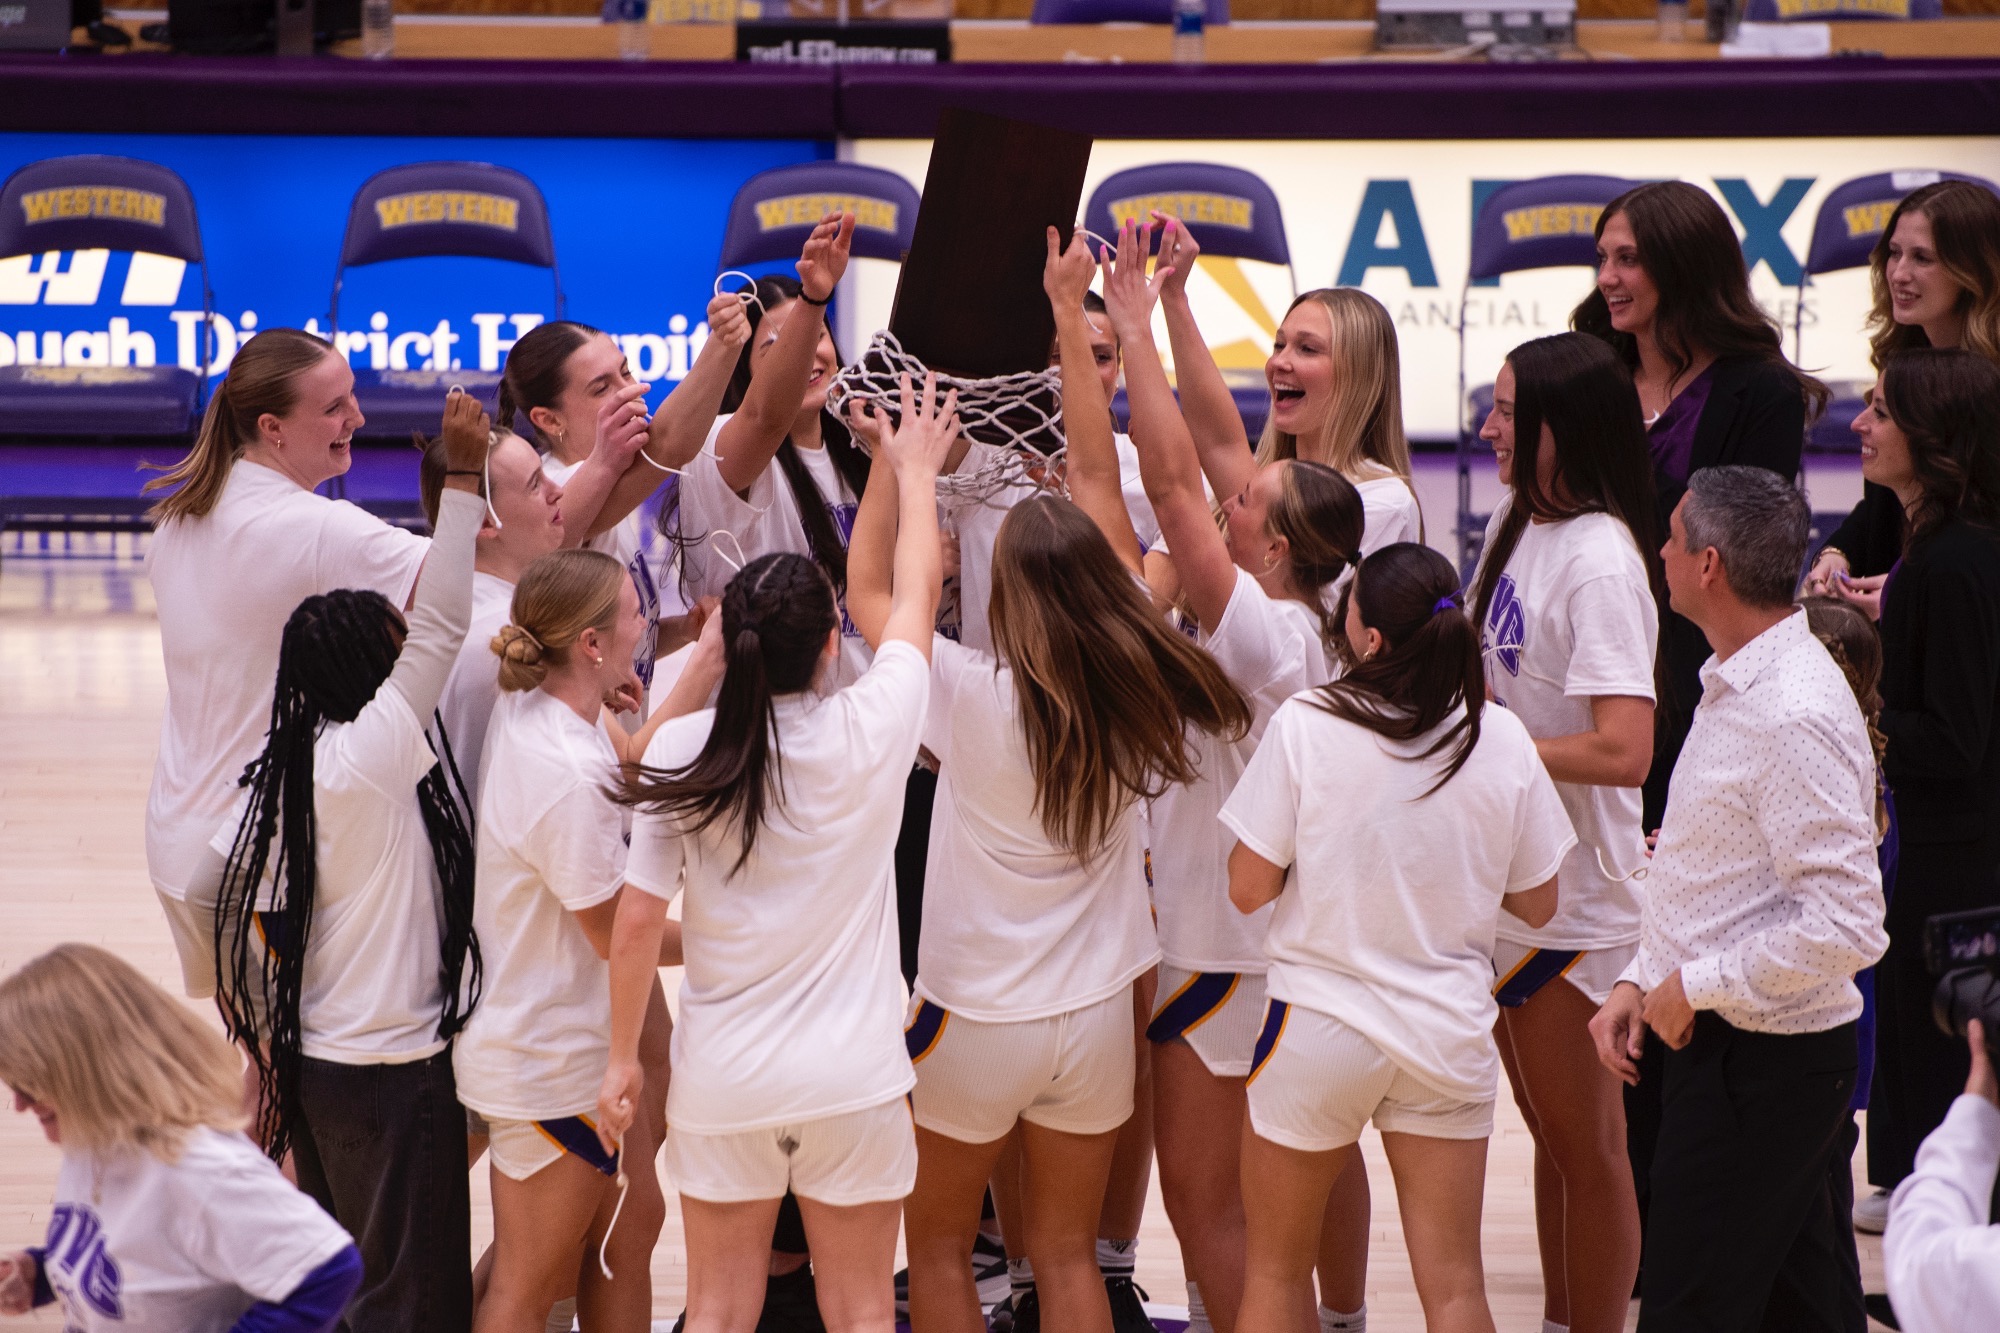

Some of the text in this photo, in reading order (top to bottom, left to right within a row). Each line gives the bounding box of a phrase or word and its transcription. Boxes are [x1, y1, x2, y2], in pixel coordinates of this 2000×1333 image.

[20, 185, 167, 228] WESTERN
[375, 190, 519, 232] WESTERN
[754, 192, 899, 235] WESTERN
[1107, 191, 1254, 232] WESTERN
[1335, 178, 1817, 287] AX
